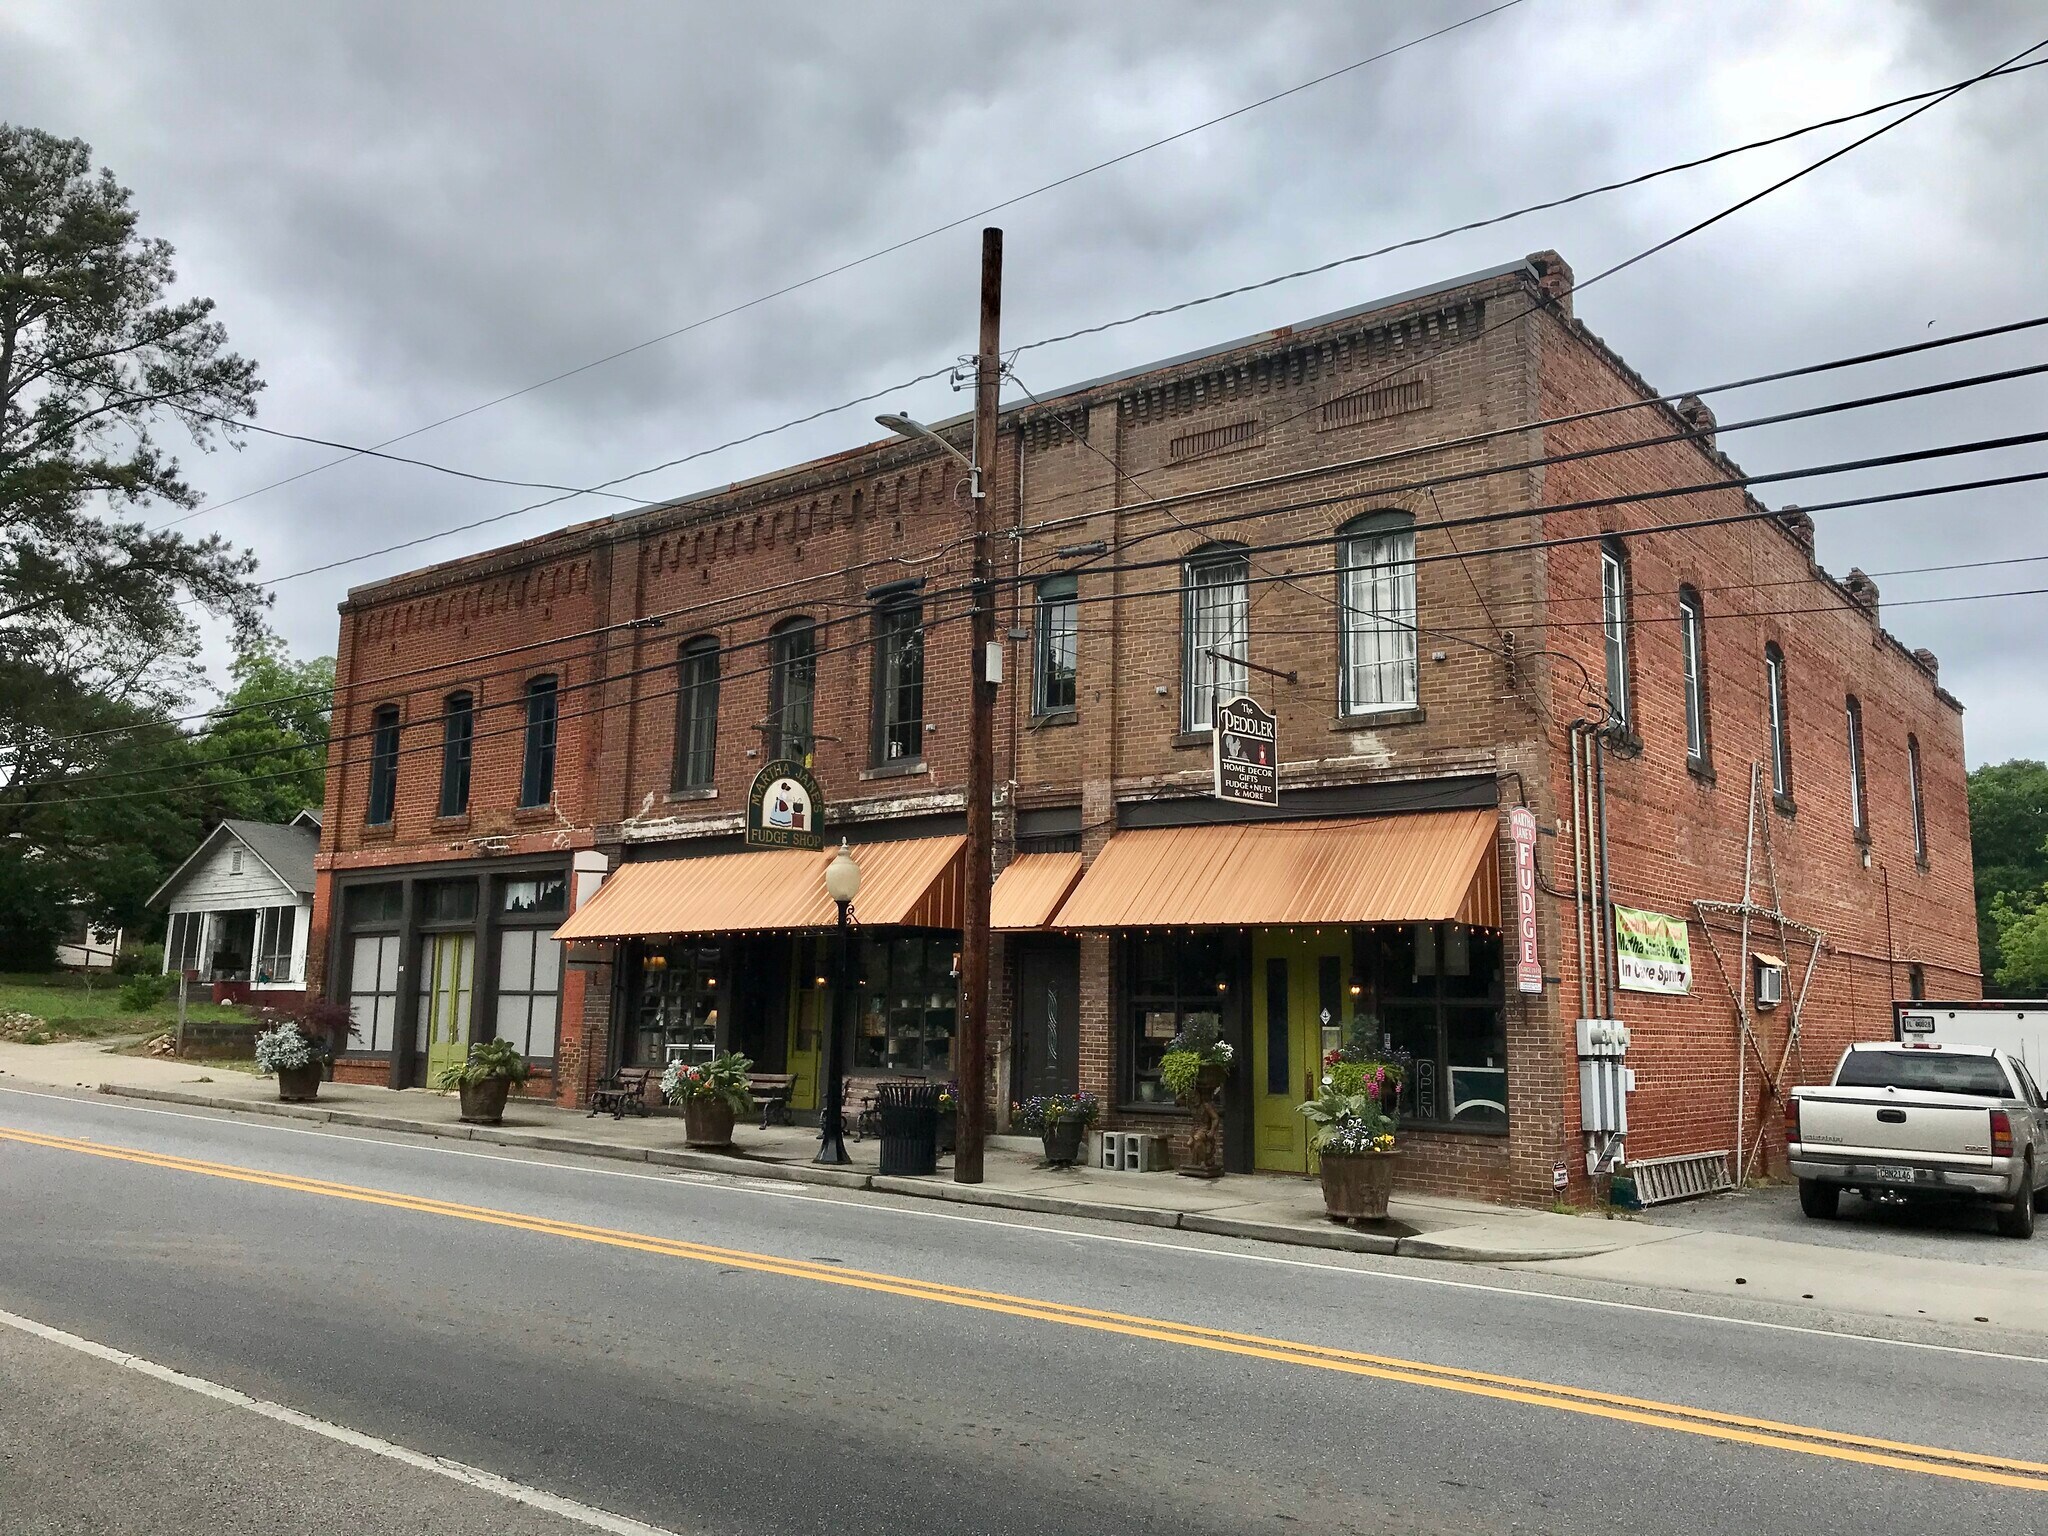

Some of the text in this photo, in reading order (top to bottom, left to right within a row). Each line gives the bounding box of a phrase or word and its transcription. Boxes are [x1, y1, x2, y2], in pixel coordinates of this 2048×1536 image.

[1241, 703, 1253, 714] The
[1220, 709, 1274, 738] PEDDLER
[1223, 763, 1273, 777] HOME DECOR
[751, 763, 790, 806] MARTHA
[1225, 780, 1272, 793] FUDGE NUTS
[1239, 774, 1258, 783] GIFTS
[1243, 791, 1264, 800] MORE
[1512, 813, 1534, 828] MARTHA
[751, 829, 821, 847] FUDGE SHOP
[1519, 843, 1535, 963] FUDGE
[1621, 959, 1631, 977] In
[1420, 1063, 1432, 1118] OPEN
